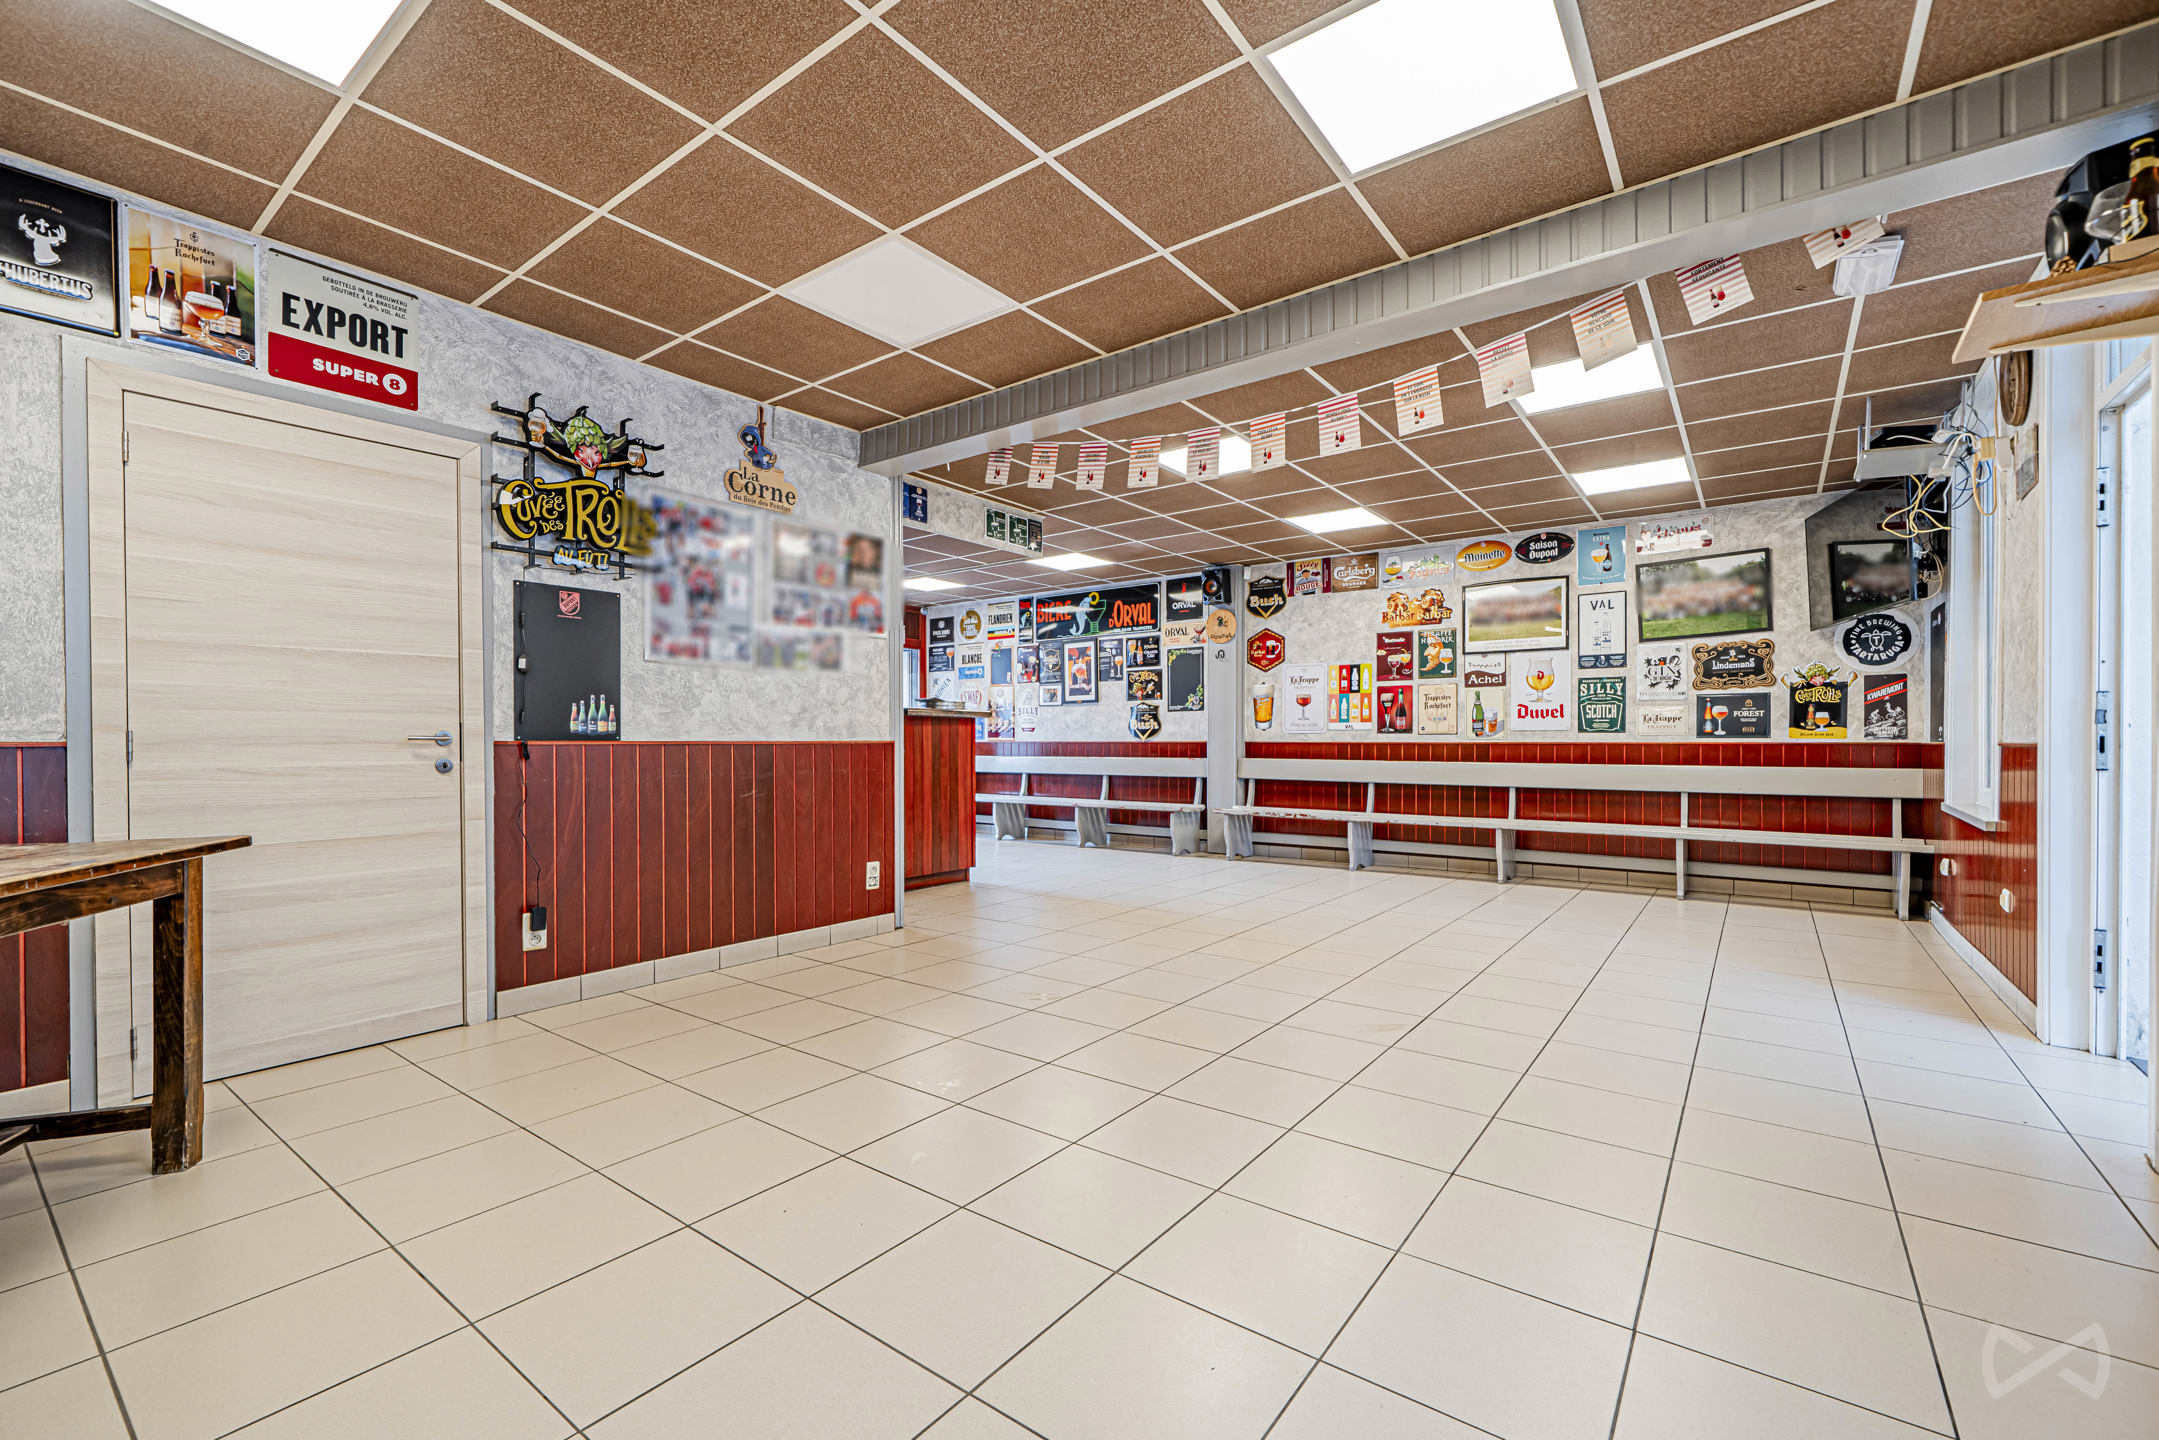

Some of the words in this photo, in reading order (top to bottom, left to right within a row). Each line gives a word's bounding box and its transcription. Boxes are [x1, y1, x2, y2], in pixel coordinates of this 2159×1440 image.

[174, 238, 215, 256] Trappistes
[175, 248, 215, 266] Rochefort
[1690, 257, 1724, 276] FORTEMENT
[322, 275, 356, 291] GEBOTTELD
[366, 289, 374, 297] DE
[330, 285, 360, 299] SOUTIRÉE
[367, 296, 375, 304] LA
[376, 298, 408, 314] BRASSERIE
[282, 291, 408, 359] EXPORT
[312, 358, 379, 386] SUPER
[743, 466, 759, 482] La
[728, 471, 796, 506] Corne
[733, 493, 742, 501] du
[743, 495, 757, 504] Bois
[757, 499, 769, 508] des
[542, 519, 564, 534] DES
[1529, 540, 1558, 551] Saison
[556, 547, 573, 562] AU
[1464, 549, 1505, 563] Moinette
[1529, 548, 1558, 560] Dupont
[1296, 560, 1319, 571] Silly
[1334, 564, 1375, 581] Carlsberg
[1294, 582, 1322, 592] ROUGE
[1172, 600, 1197, 610] ORVAL
[1249, 594, 1284, 608] Bush
[1590, 599, 1615, 611] VAL
[988, 613, 1013, 625] FLANDRIEN
[1165, 626, 1190, 637] ORVAL
[1849, 622, 1865, 639] FINE
[1866, 618, 1903, 635] BREWING
[1873, 636, 1880, 646] T
[1850, 639, 1905, 661] TARTARUGA
[961, 653, 983, 665] BLANCHE
[1290, 675, 1299, 685] La
[1299, 675, 1320, 685] Trappe
[1468, 674, 1503, 684] Achel
[1537, 670, 1545, 680] D
[935, 677, 952, 699] NGHIEN
[1580, 682, 1624, 696] SILLY
[1804, 685, 1842, 703] TROLLS
[1866, 682, 1904, 701] KWAREMONT
[1424, 693, 1451, 702] Trappistes
[1017, 707, 1039, 716] SILLY
[1517, 703, 1565, 719] Duvel
[1586, 704, 1617, 718] SCOTCH
[1131, 718, 1159, 730] Bush
[1652, 713, 1682, 724] Trappe
